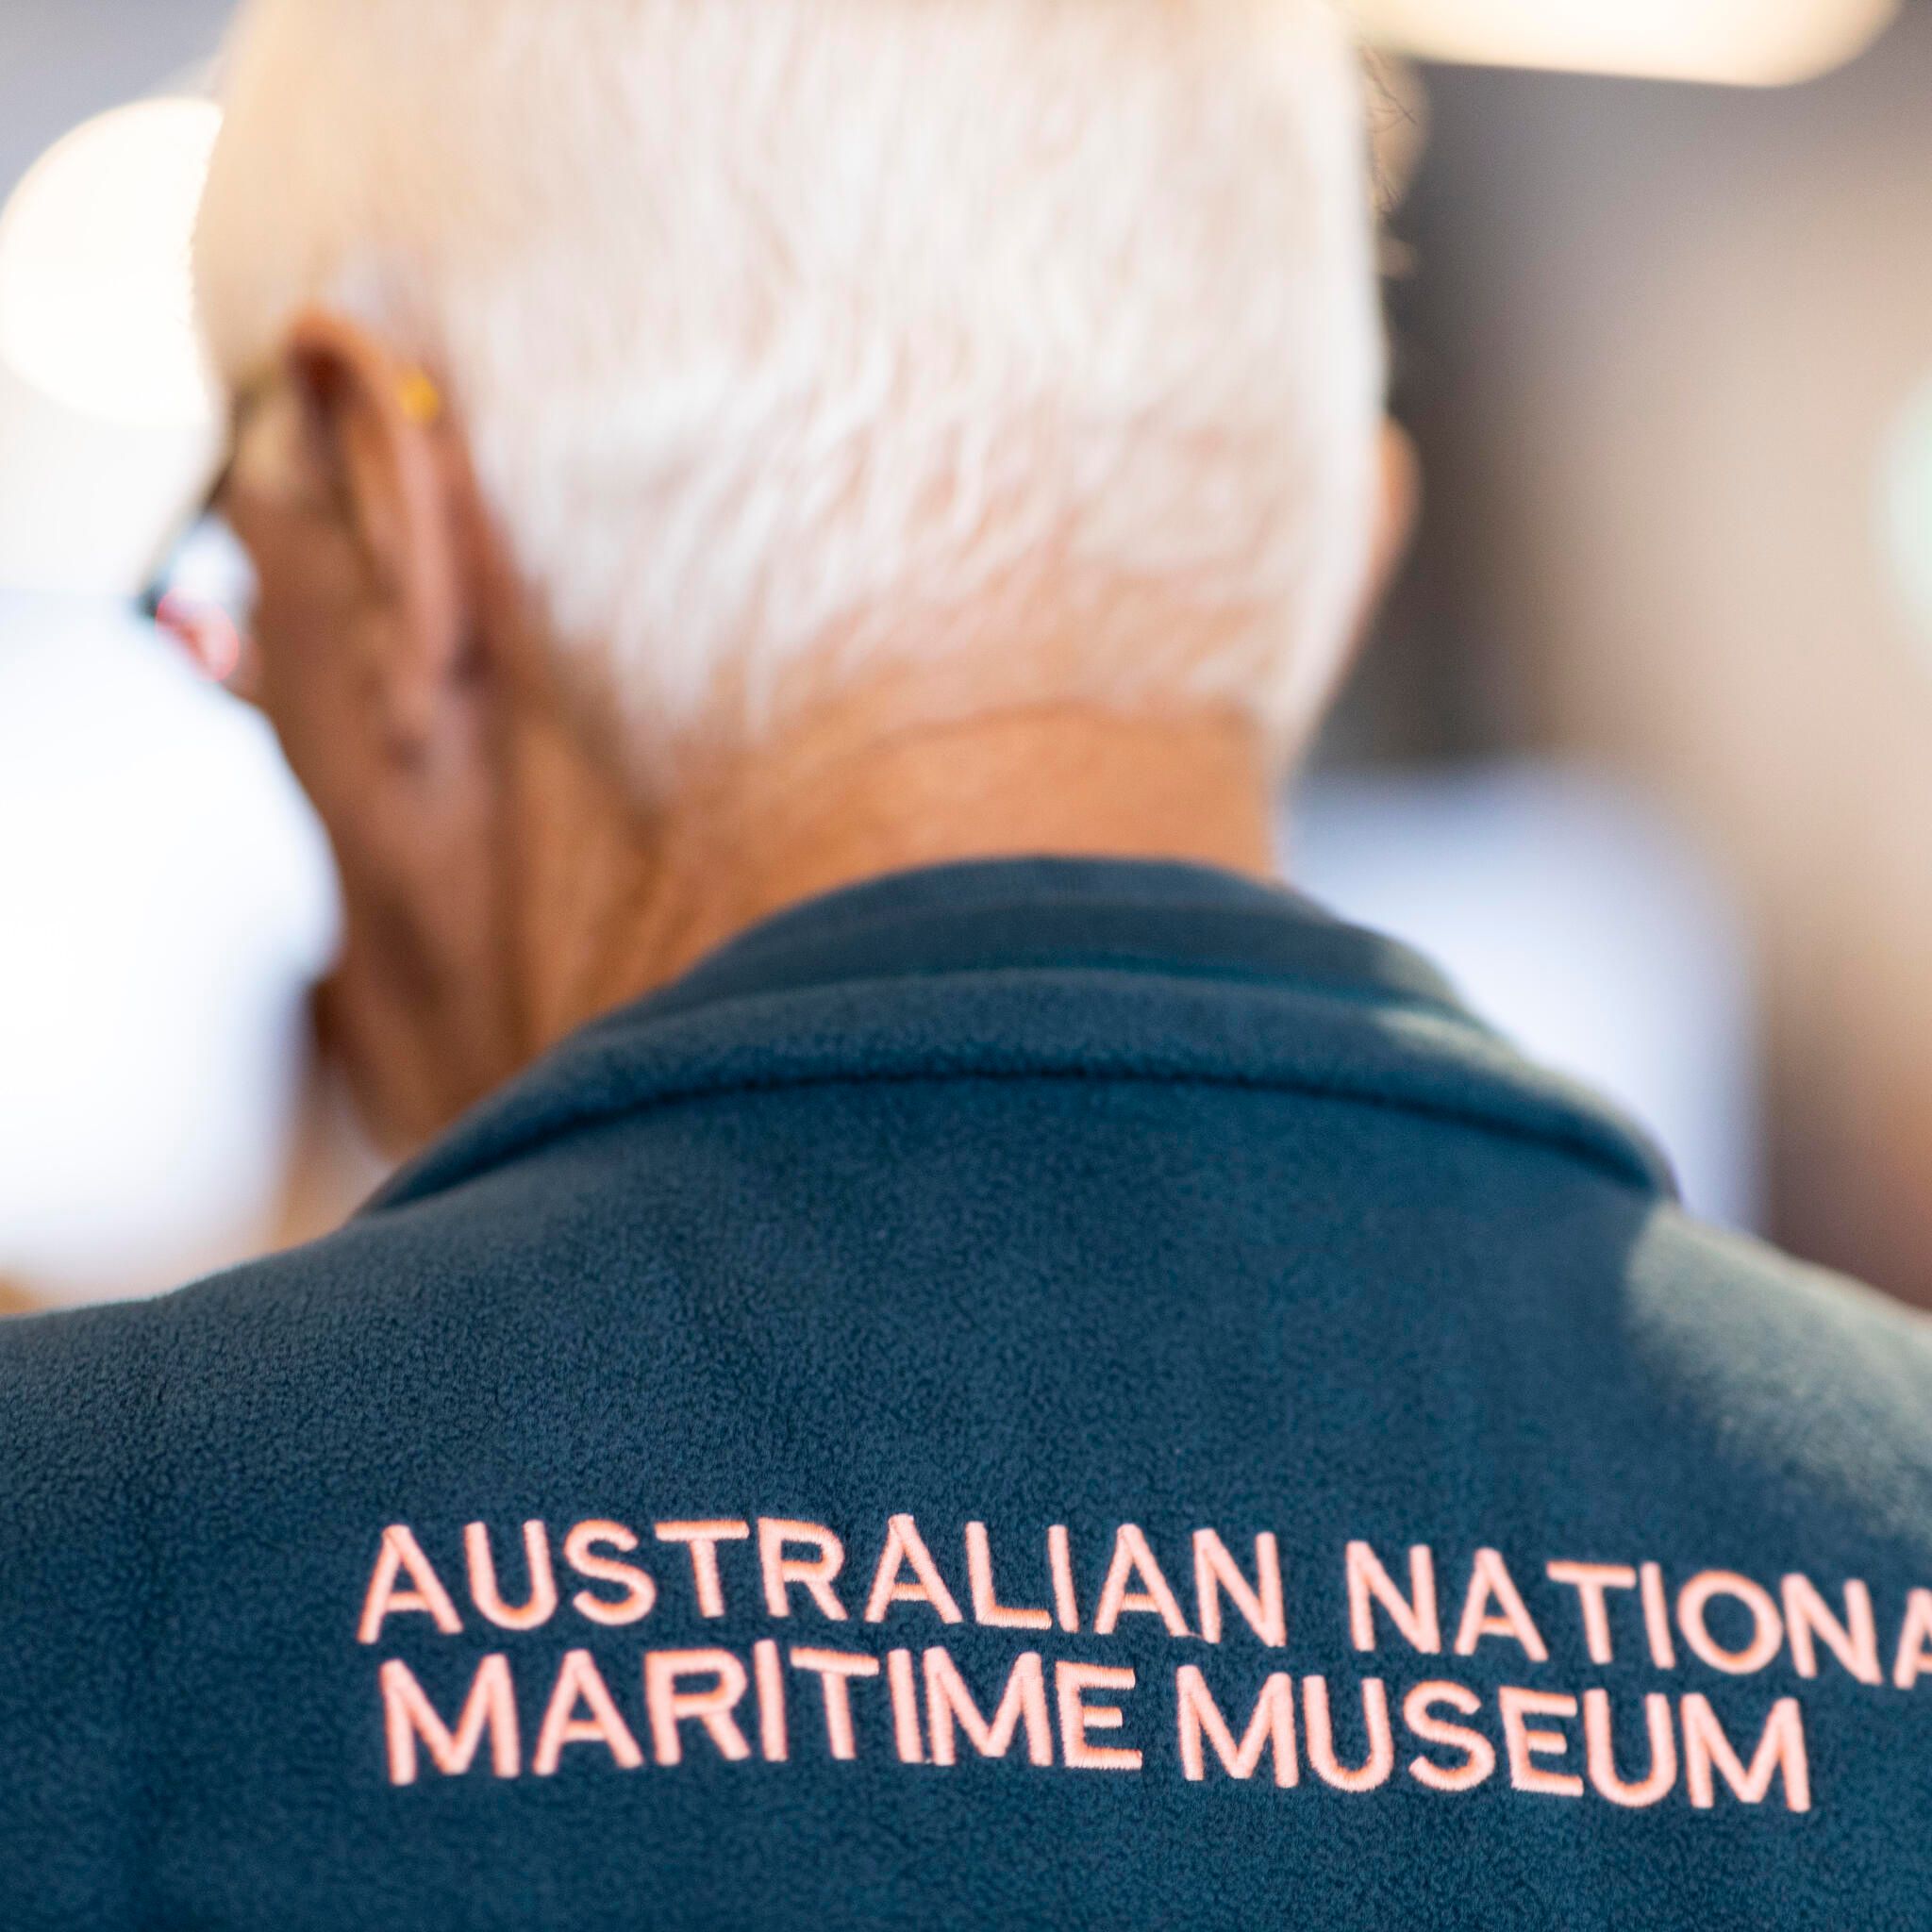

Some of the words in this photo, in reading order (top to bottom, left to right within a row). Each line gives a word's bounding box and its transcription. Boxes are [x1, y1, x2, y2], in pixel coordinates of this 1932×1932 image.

[358, 1513, 1287, 1647] AUSTRALIAN
[379, 1639, 1143, 1786] MARITIME
[1175, 1665, 1810, 1813] MUSEUM
